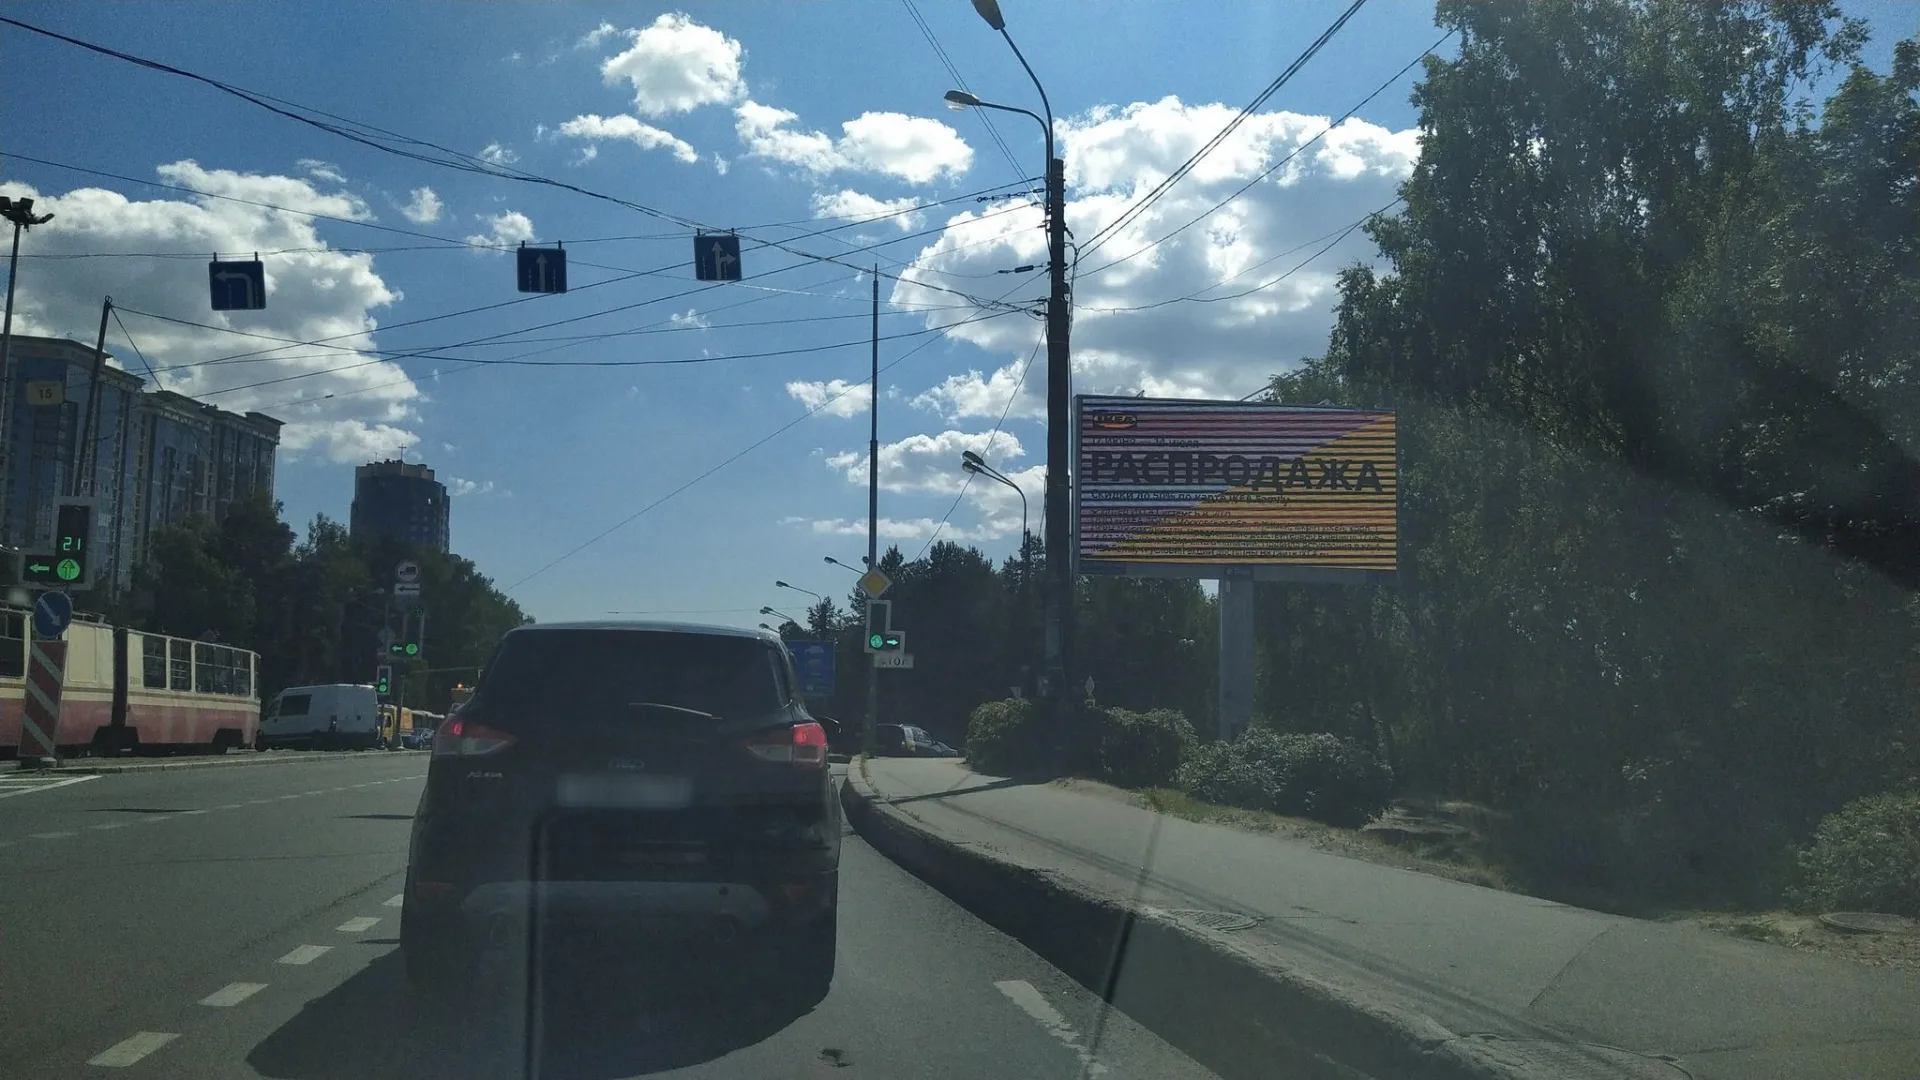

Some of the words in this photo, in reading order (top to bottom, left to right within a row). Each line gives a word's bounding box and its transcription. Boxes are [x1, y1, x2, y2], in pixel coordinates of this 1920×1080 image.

[1091, 452, 1383, 494] РАСПРОДАЖА
[1090, 489, 1134, 500] Скидки
[1137, 490, 1150, 501] до
[1178, 493, 1192, 501] по
[1195, 493, 1227, 503] карте
[1229, 494, 1252, 503] IKEA
[63, 536, 81, 550] 21
